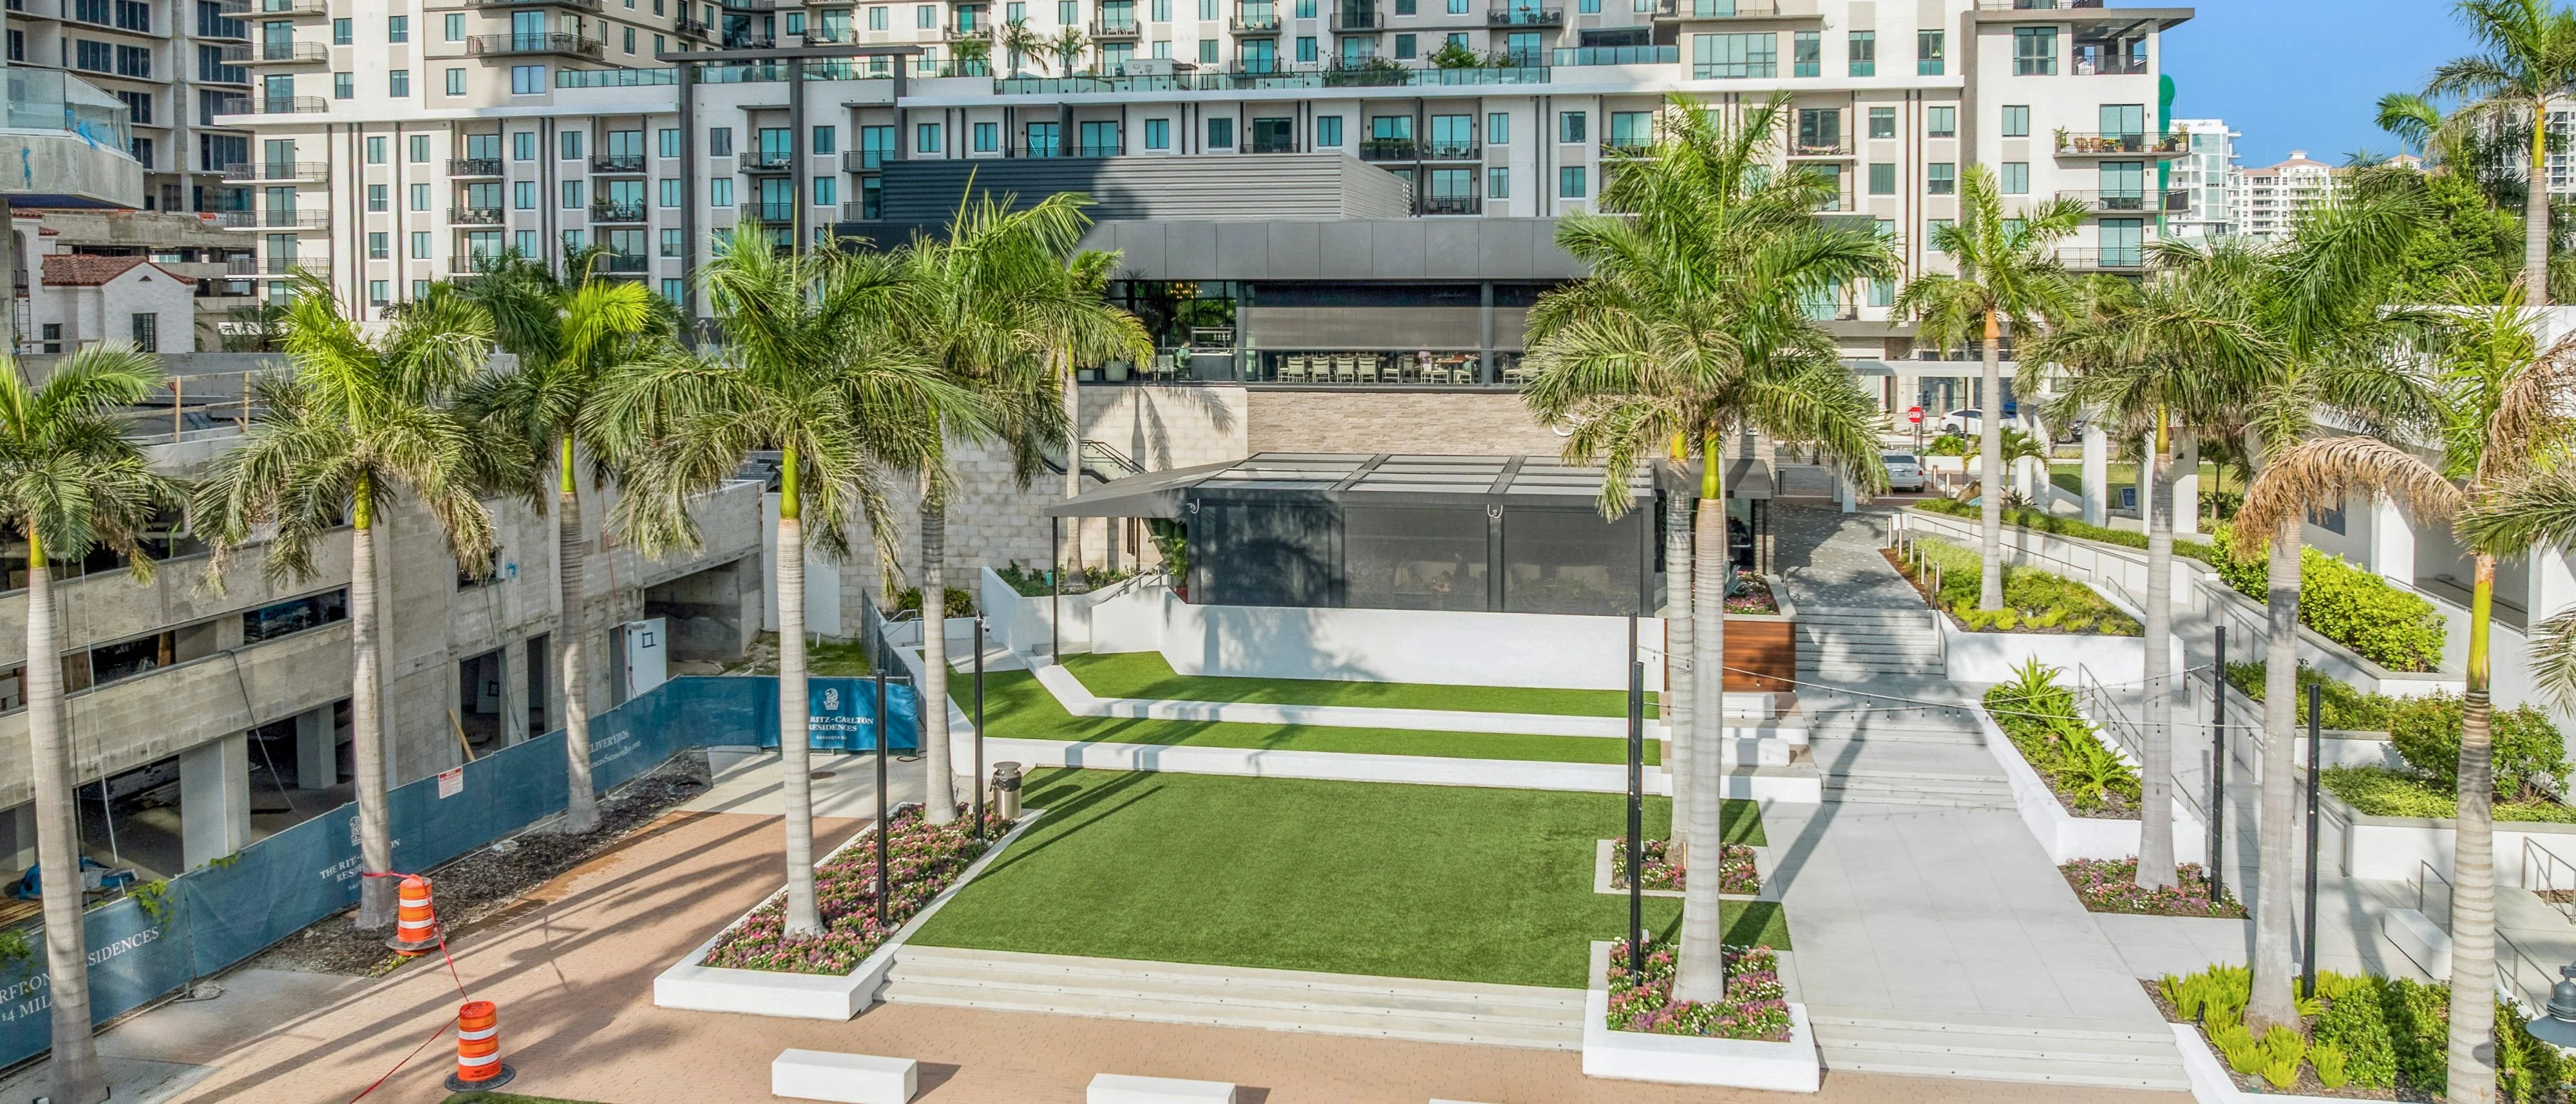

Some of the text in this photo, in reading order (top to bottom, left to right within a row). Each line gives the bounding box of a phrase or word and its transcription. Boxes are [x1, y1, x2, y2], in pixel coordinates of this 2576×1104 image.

[589, 735, 616, 754] LIVERY
[319, 864, 338, 879] THE
[0, 926, 160, 1004] RFRON SIDENCES
[2, 1009, 15, 1022] $4
